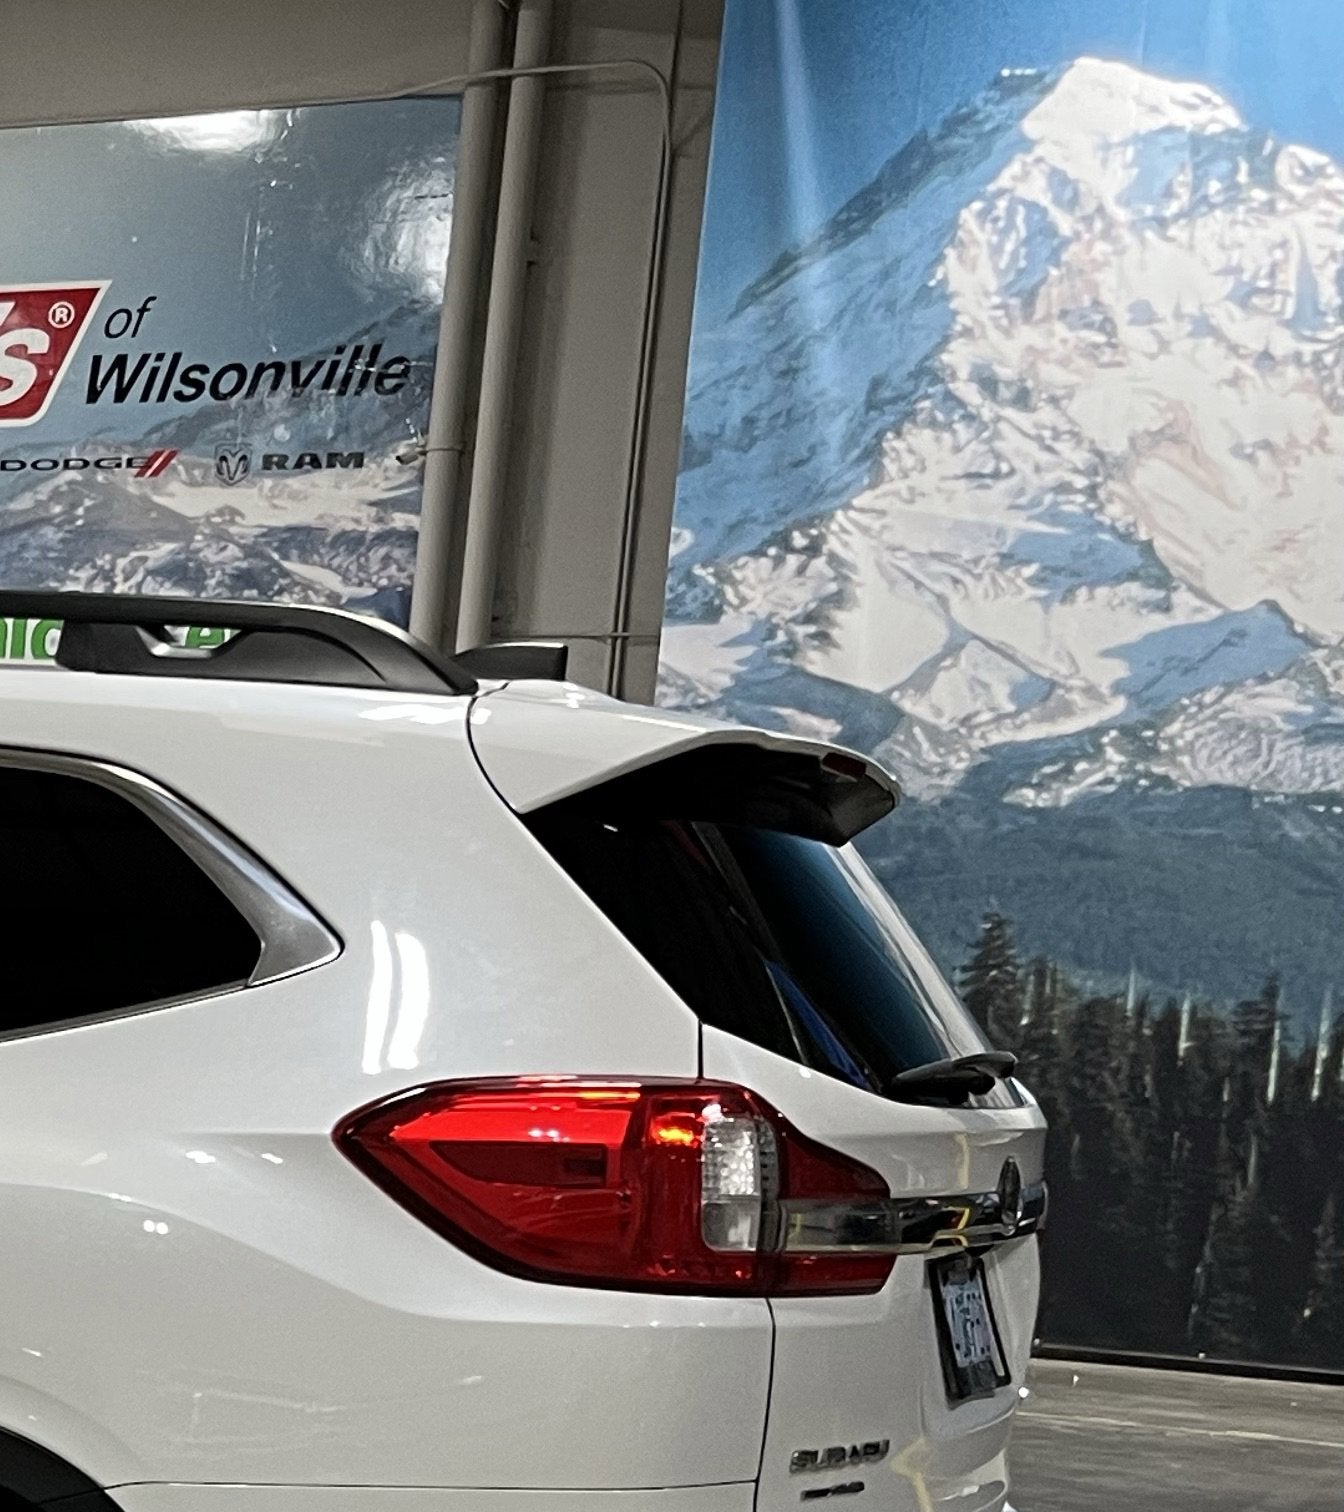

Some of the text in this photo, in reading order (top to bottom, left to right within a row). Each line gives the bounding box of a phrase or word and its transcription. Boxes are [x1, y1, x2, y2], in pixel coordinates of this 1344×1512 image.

[104, 296, 157, 339] of
[86, 341, 411, 404] Wilsonville
[0, 456, 151, 473] DODGE
[262, 451, 365, 471] RAM
